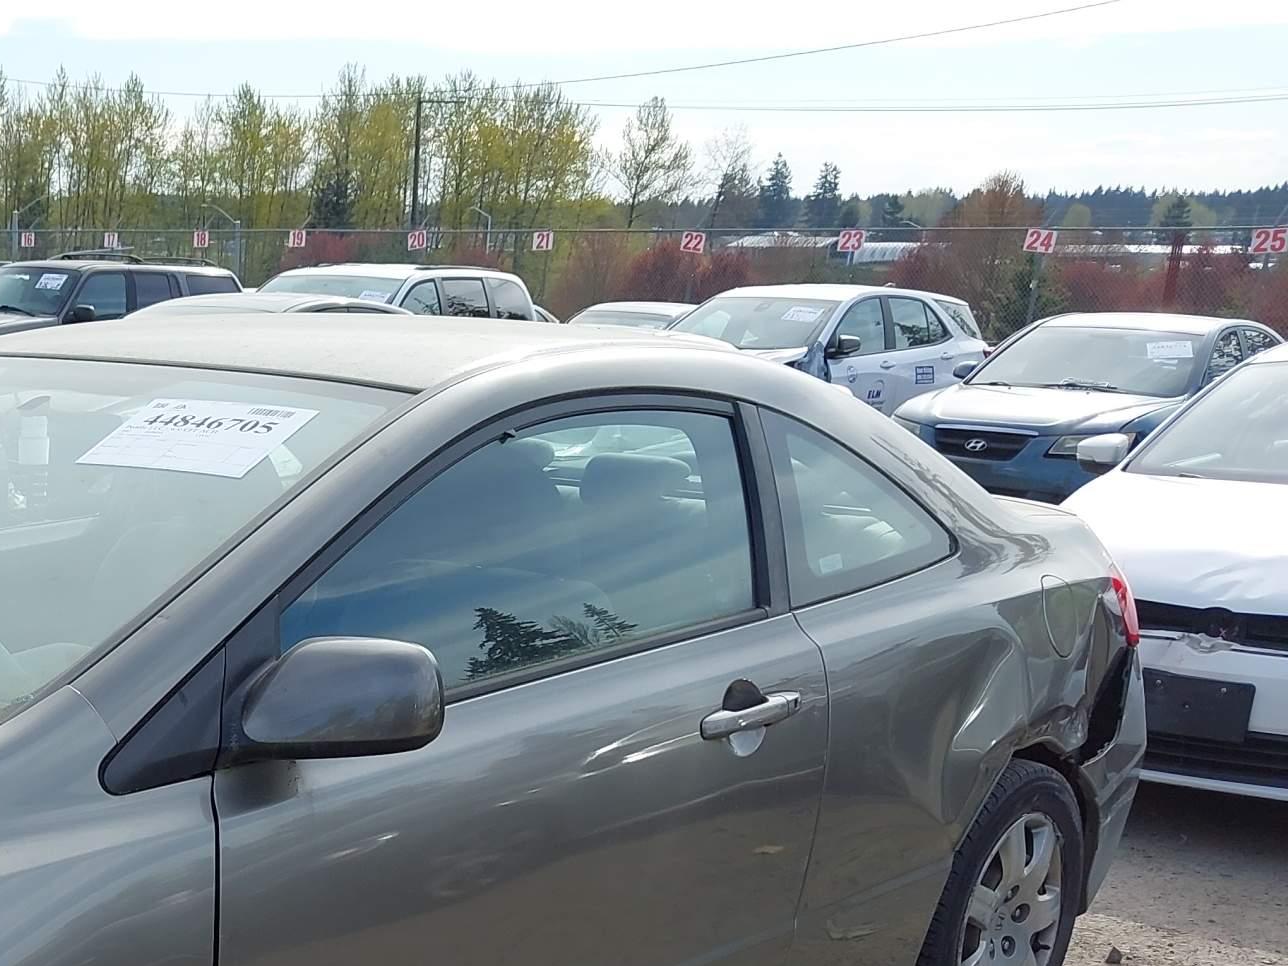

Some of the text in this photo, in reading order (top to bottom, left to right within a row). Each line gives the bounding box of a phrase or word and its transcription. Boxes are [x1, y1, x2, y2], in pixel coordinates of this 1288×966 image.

[23, 233, 33, 246] 16
[196, 232, 207, 247] 18
[292, 231, 304, 246] 19
[409, 231, 425, 248] 20
[537, 232, 551, 249] 21
[683, 232, 704, 251] 22
[840, 231, 863, 250] 23
[1025, 229, 1054, 251] 24
[1253, 229, 1287, 252] 25
[143, 413, 280, 434] 44846705
